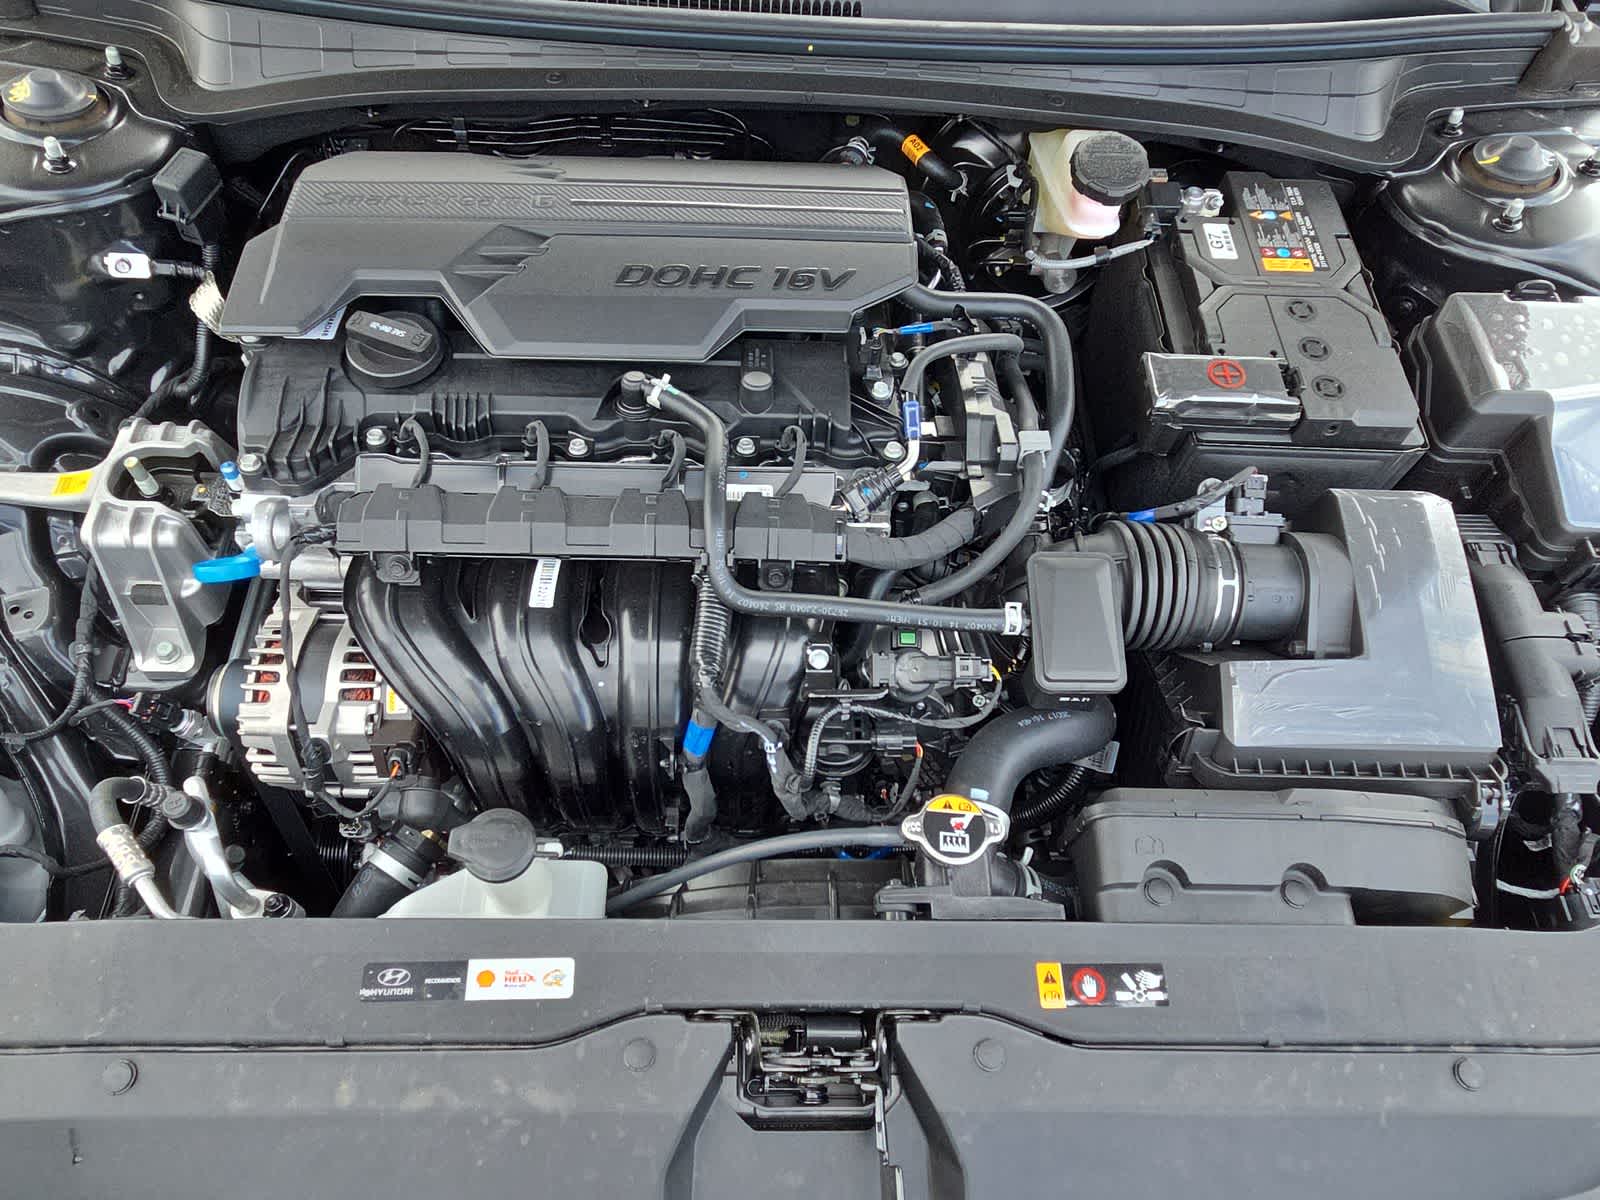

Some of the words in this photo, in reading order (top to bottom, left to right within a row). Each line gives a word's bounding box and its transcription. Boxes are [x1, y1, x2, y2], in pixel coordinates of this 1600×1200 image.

[614, 263, 762, 289] DOHC
[772, 265, 857, 291] 16V
[504, 974, 536, 983] HELIX
